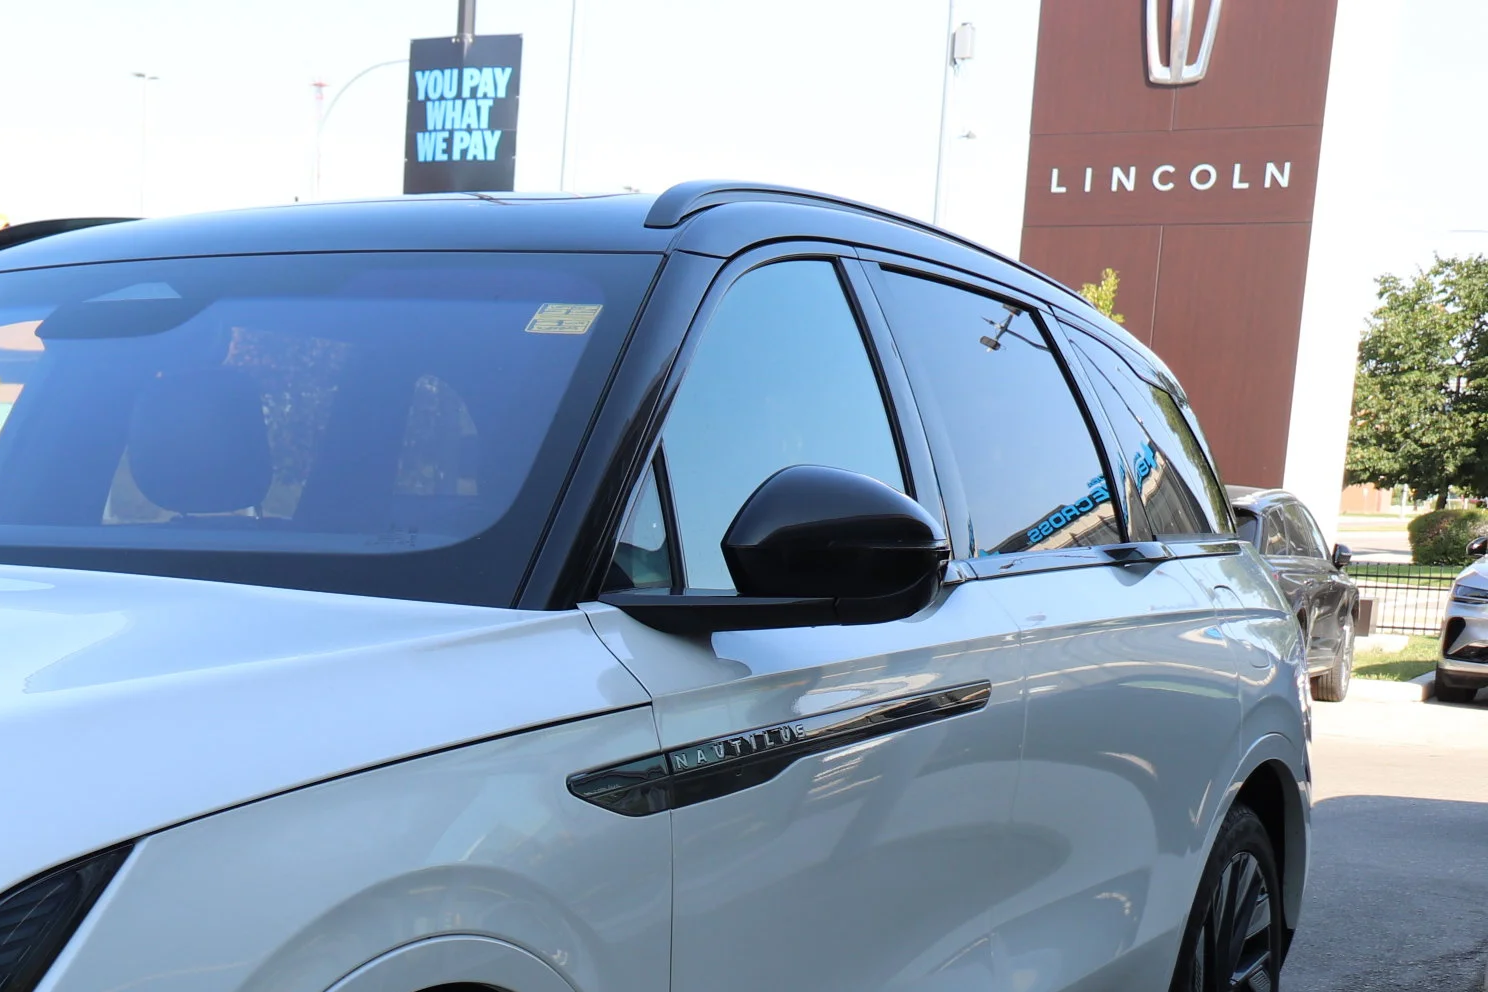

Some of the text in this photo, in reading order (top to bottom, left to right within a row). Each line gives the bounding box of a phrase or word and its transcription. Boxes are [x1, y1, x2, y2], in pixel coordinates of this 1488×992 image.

[415, 66, 512, 101] YOU PAY
[426, 99, 494, 131] WHAT
[416, 130, 502, 162] WE PAY
[1050, 161, 1291, 194] LINCOLN
[673, 723, 807, 770] NAUTILUS
